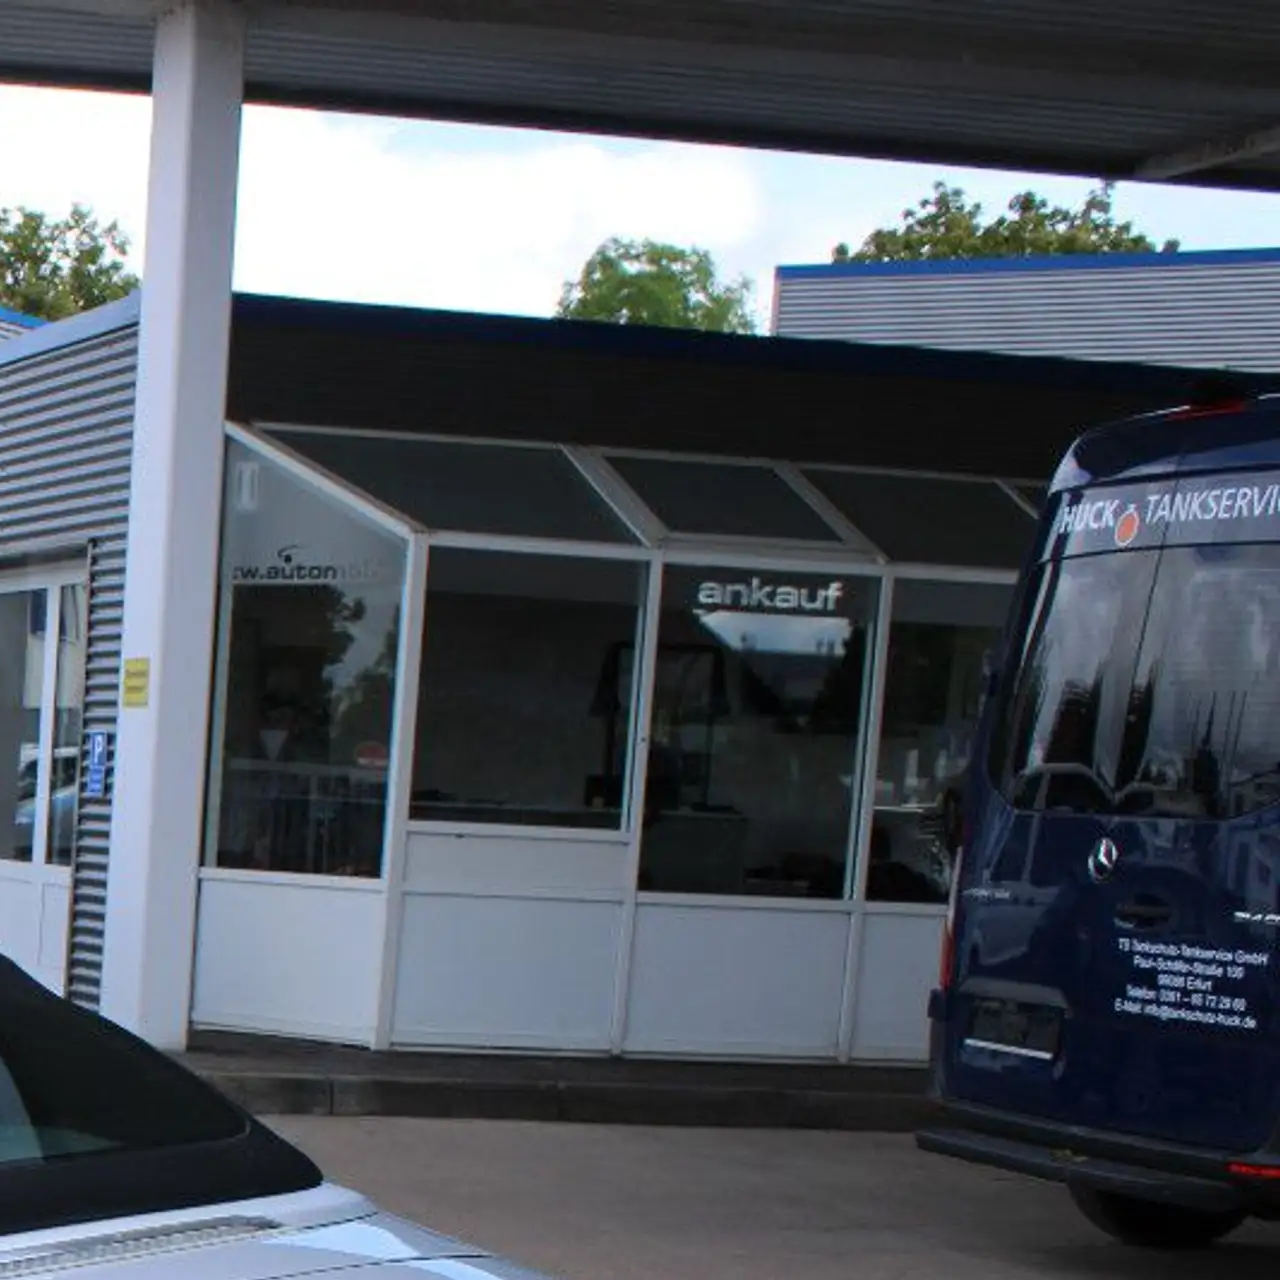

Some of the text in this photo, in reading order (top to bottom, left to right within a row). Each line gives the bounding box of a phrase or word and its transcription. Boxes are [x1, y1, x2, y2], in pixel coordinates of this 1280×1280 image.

[1060, 500, 1120, 532] HUCK
[698, 575, 843, 610] ankauf
[1234, 950, 1269, 966] GmbH
[1186, 976, 1212, 991] Erfurt
